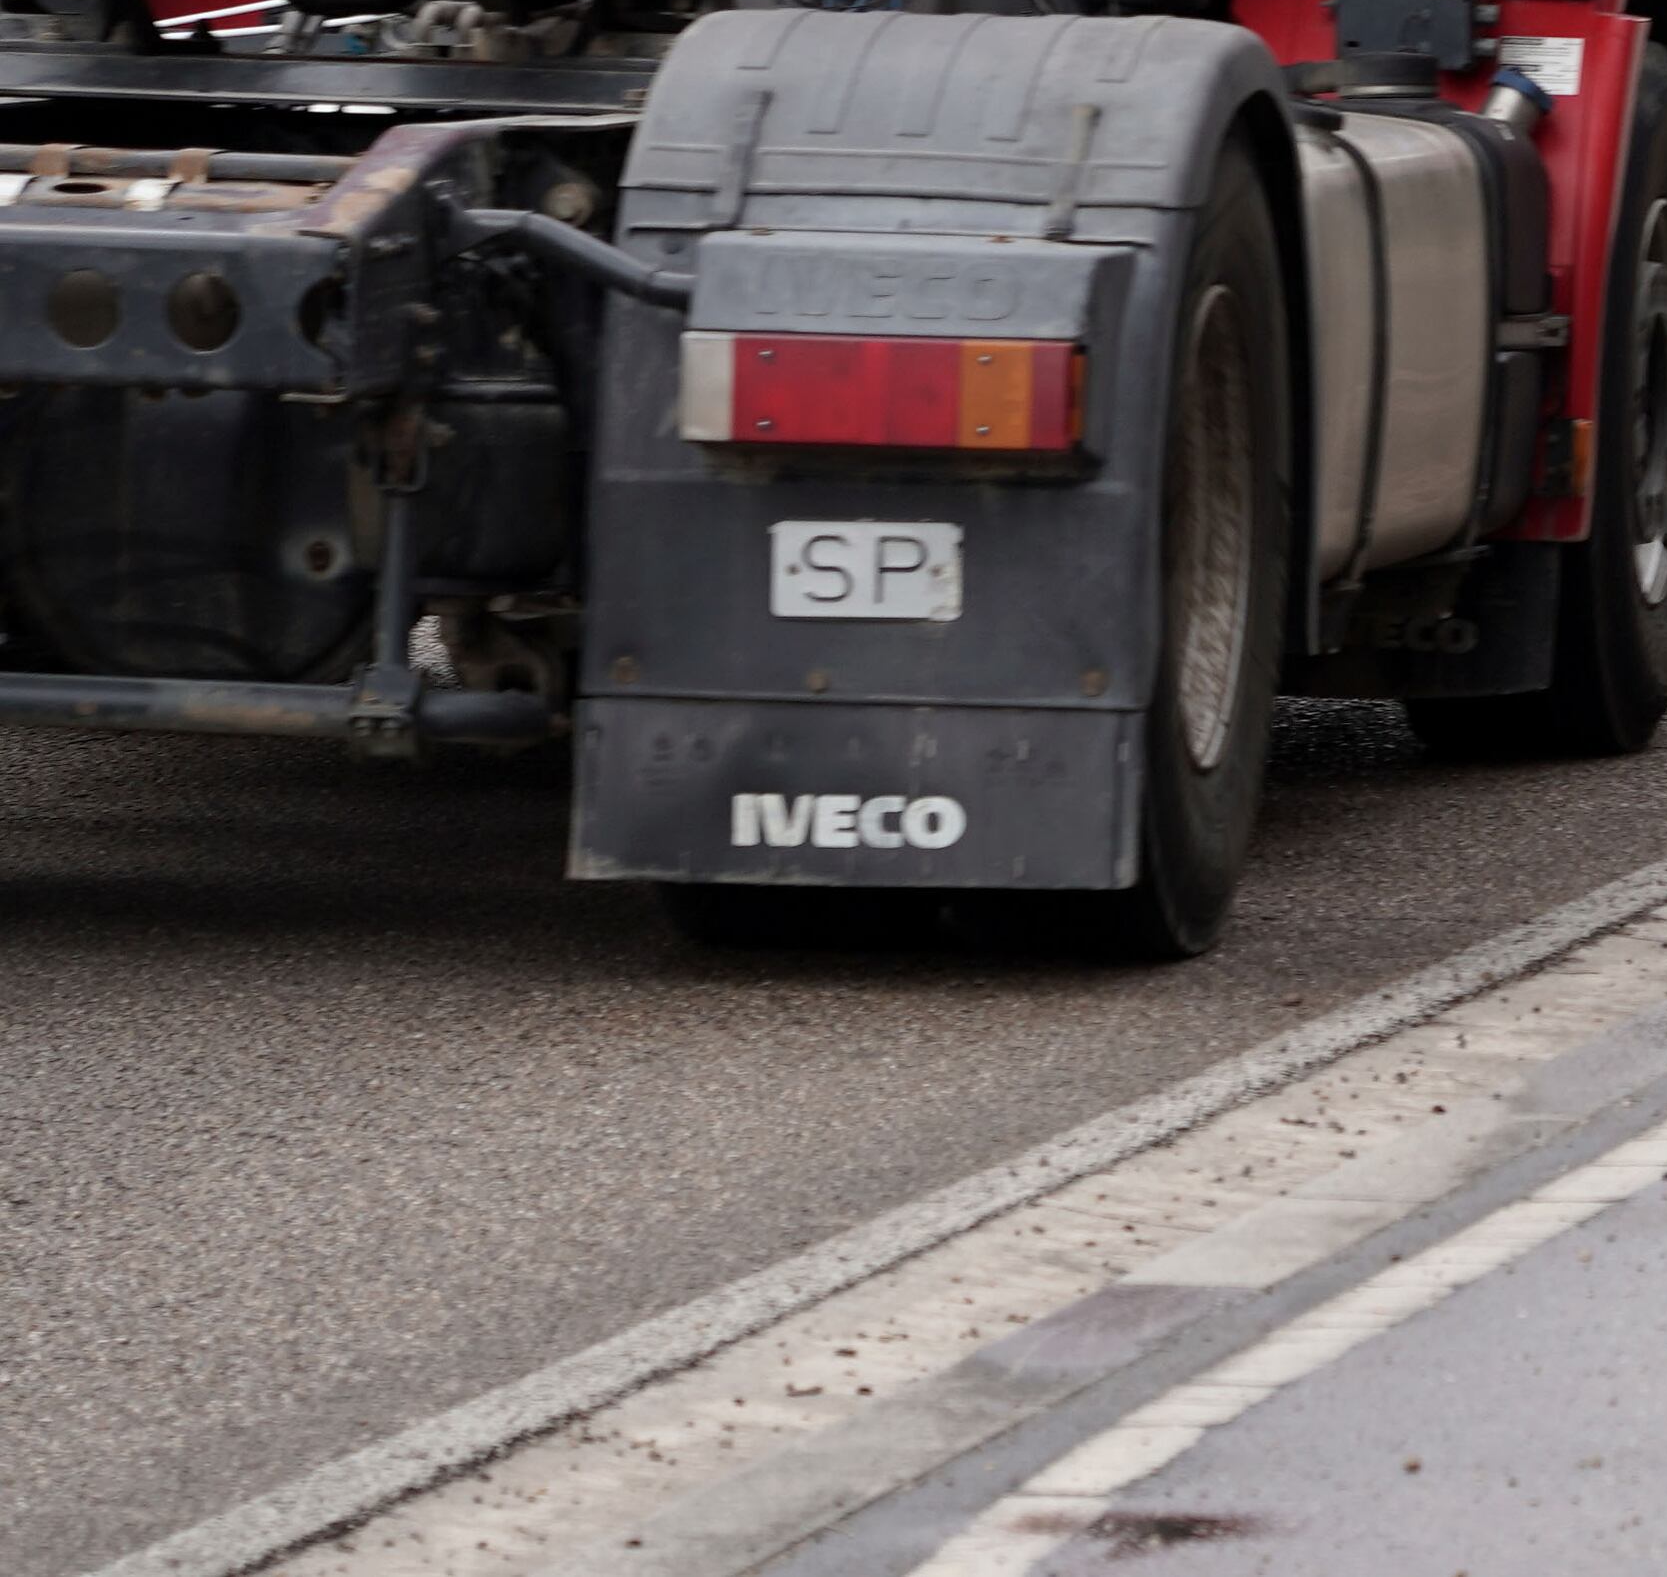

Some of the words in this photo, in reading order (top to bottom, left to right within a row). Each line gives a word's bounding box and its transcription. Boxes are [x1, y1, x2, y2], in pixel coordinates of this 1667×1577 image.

[801, 534, 928, 604] SP
[1374, 615, 1480, 655] ECO
[731, 792, 967, 850] IVECO
